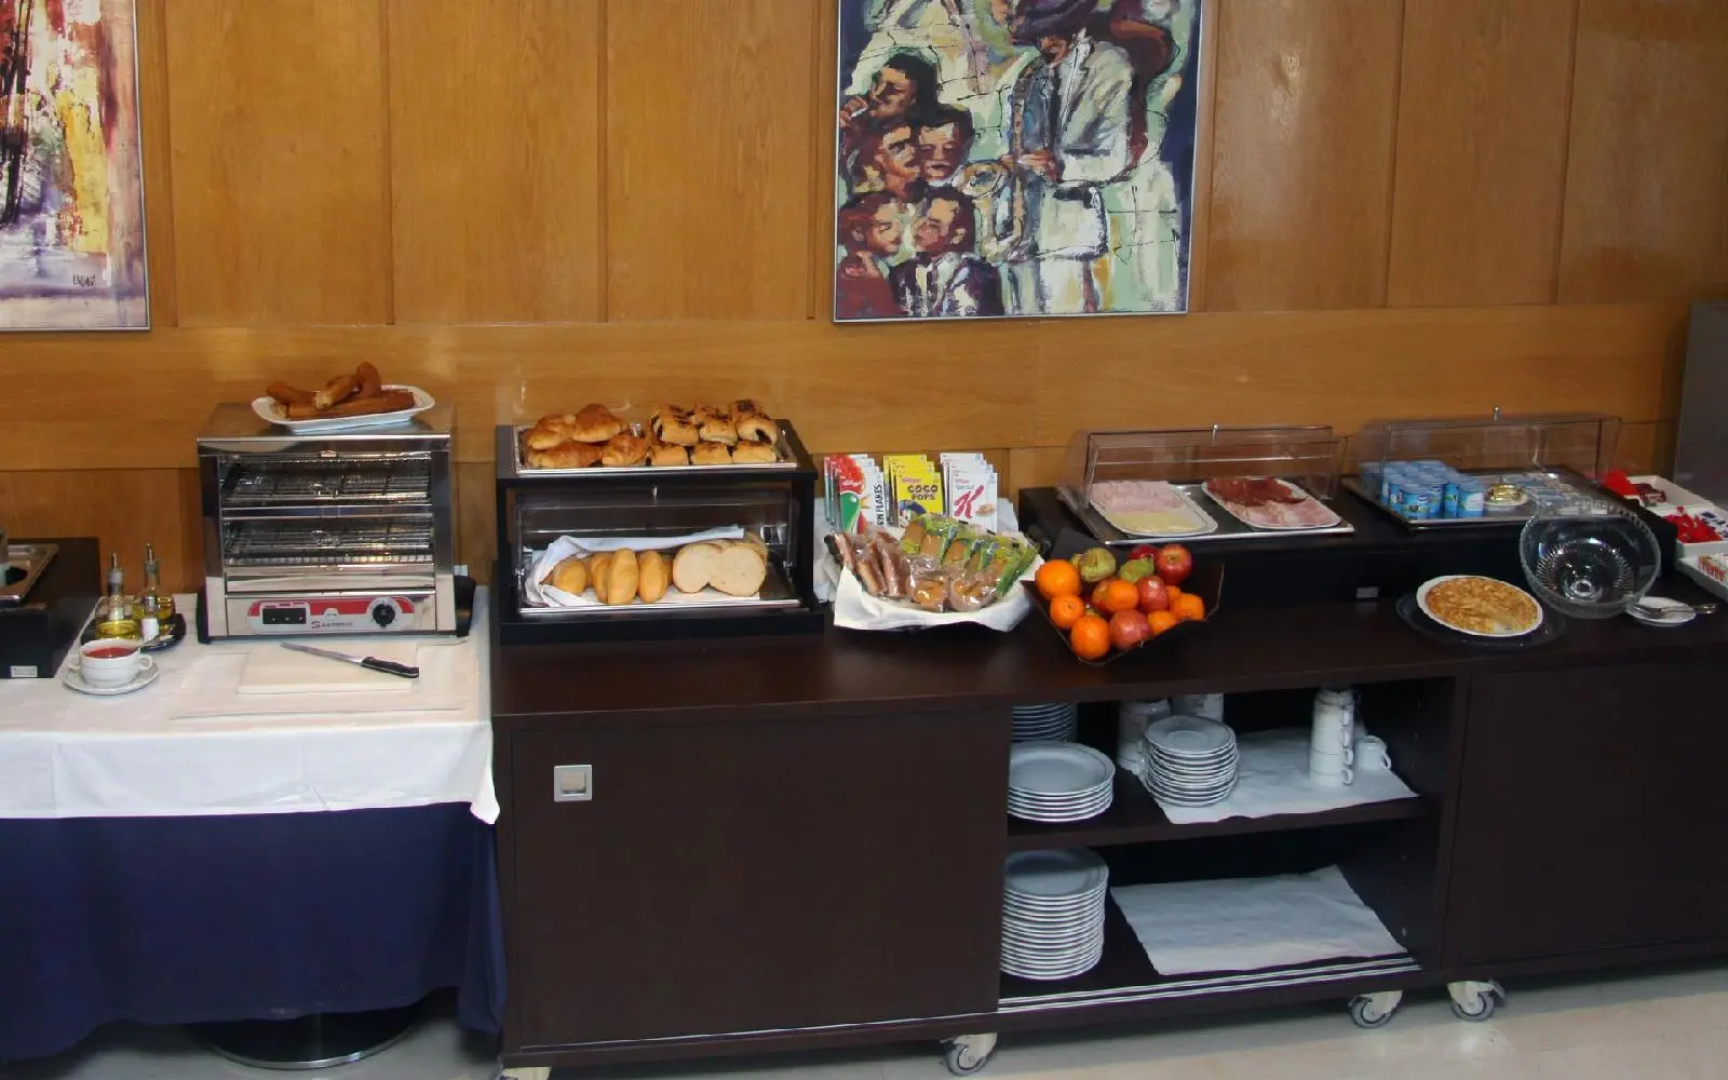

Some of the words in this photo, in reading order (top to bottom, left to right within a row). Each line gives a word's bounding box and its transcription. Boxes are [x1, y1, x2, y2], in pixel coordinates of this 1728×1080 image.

[874, 483, 884, 512] FLAKES
[907, 484, 938, 493] COCO
[911, 493, 936, 501] POPS
[954, 485, 984, 518] K
